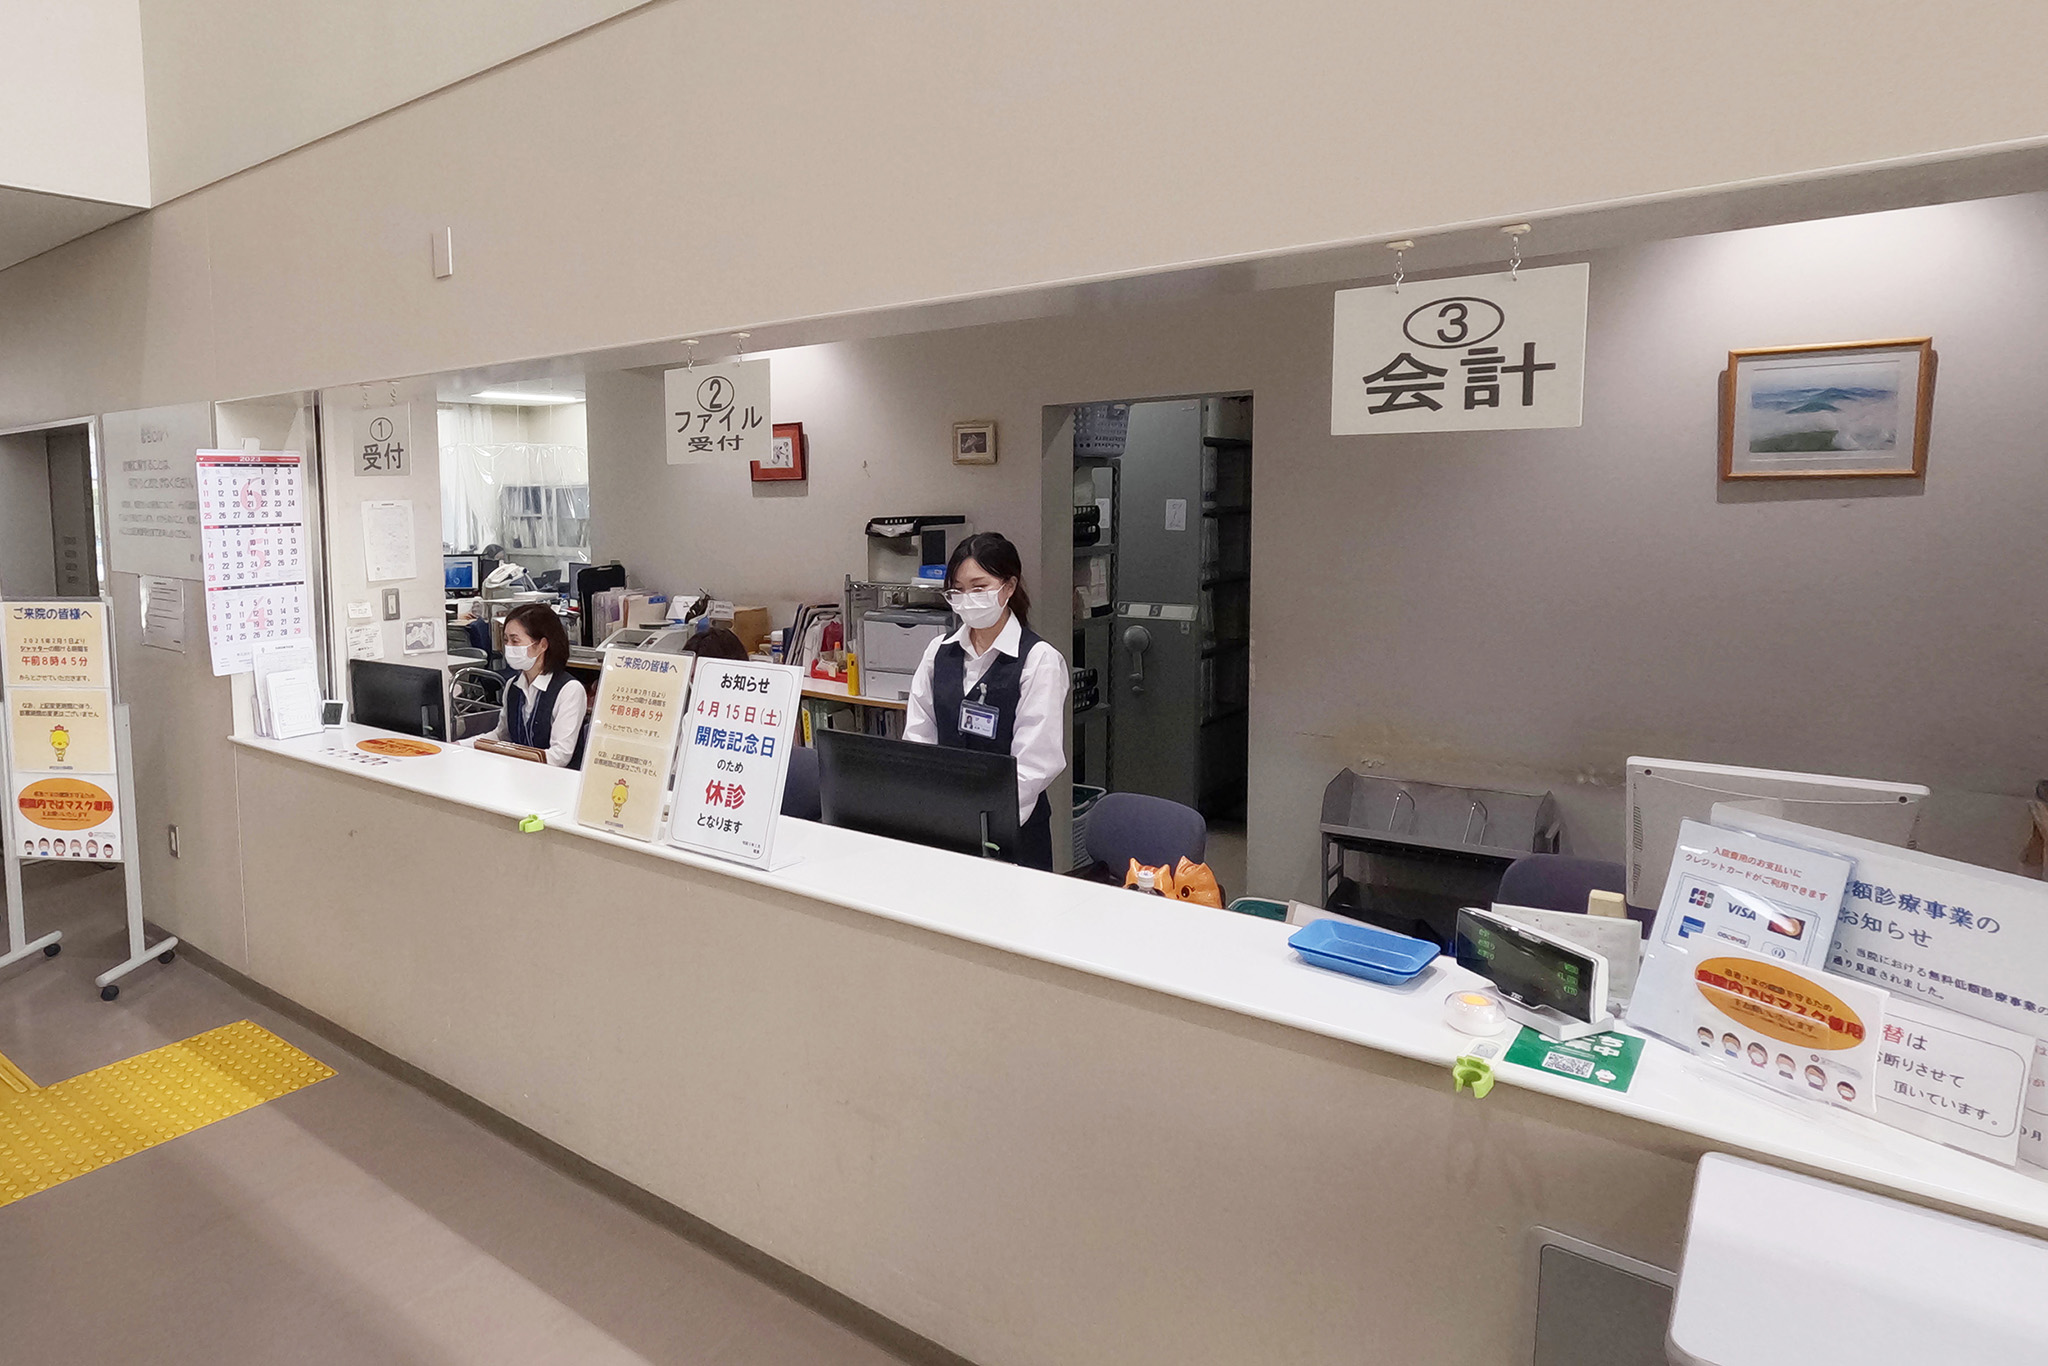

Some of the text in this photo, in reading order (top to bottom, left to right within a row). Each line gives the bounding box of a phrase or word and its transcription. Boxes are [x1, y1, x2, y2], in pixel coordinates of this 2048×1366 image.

[1362, 342, 1556, 415] 会計
[674, 405, 763, 433] ファイル
[363, 443, 404, 471] 受付
[688, 434, 744, 453] 受付
[13, 608, 92, 620] ご来院の皆様へ
[616, 656, 678, 673] ご来院の皆様へ
[720, 673, 770, 694] お知らせ
[610, 704, 663, 722] 午前8時45分
[695, 726, 776, 758] 開院記念日
[717, 759, 744, 774] のため
[706, 779, 746, 810] 休診
[697, 813, 742, 834] となります
[1712, 846, 1803, 878] 入院費用のお支払いに
[1685, 854, 1828, 901] クレジットカードがご利用できます
[1728, 902, 1757, 920] VISA
[1844, 880, 2000, 934] 額診療事業の
[1838, 907, 1932, 948] お知らせ
[1833, 956, 1944, 1000] 通り見直されました。
[1883, 1024, 1928, 1051] 替は
[1894, 1080, 1998, 1126] 頂いています。
